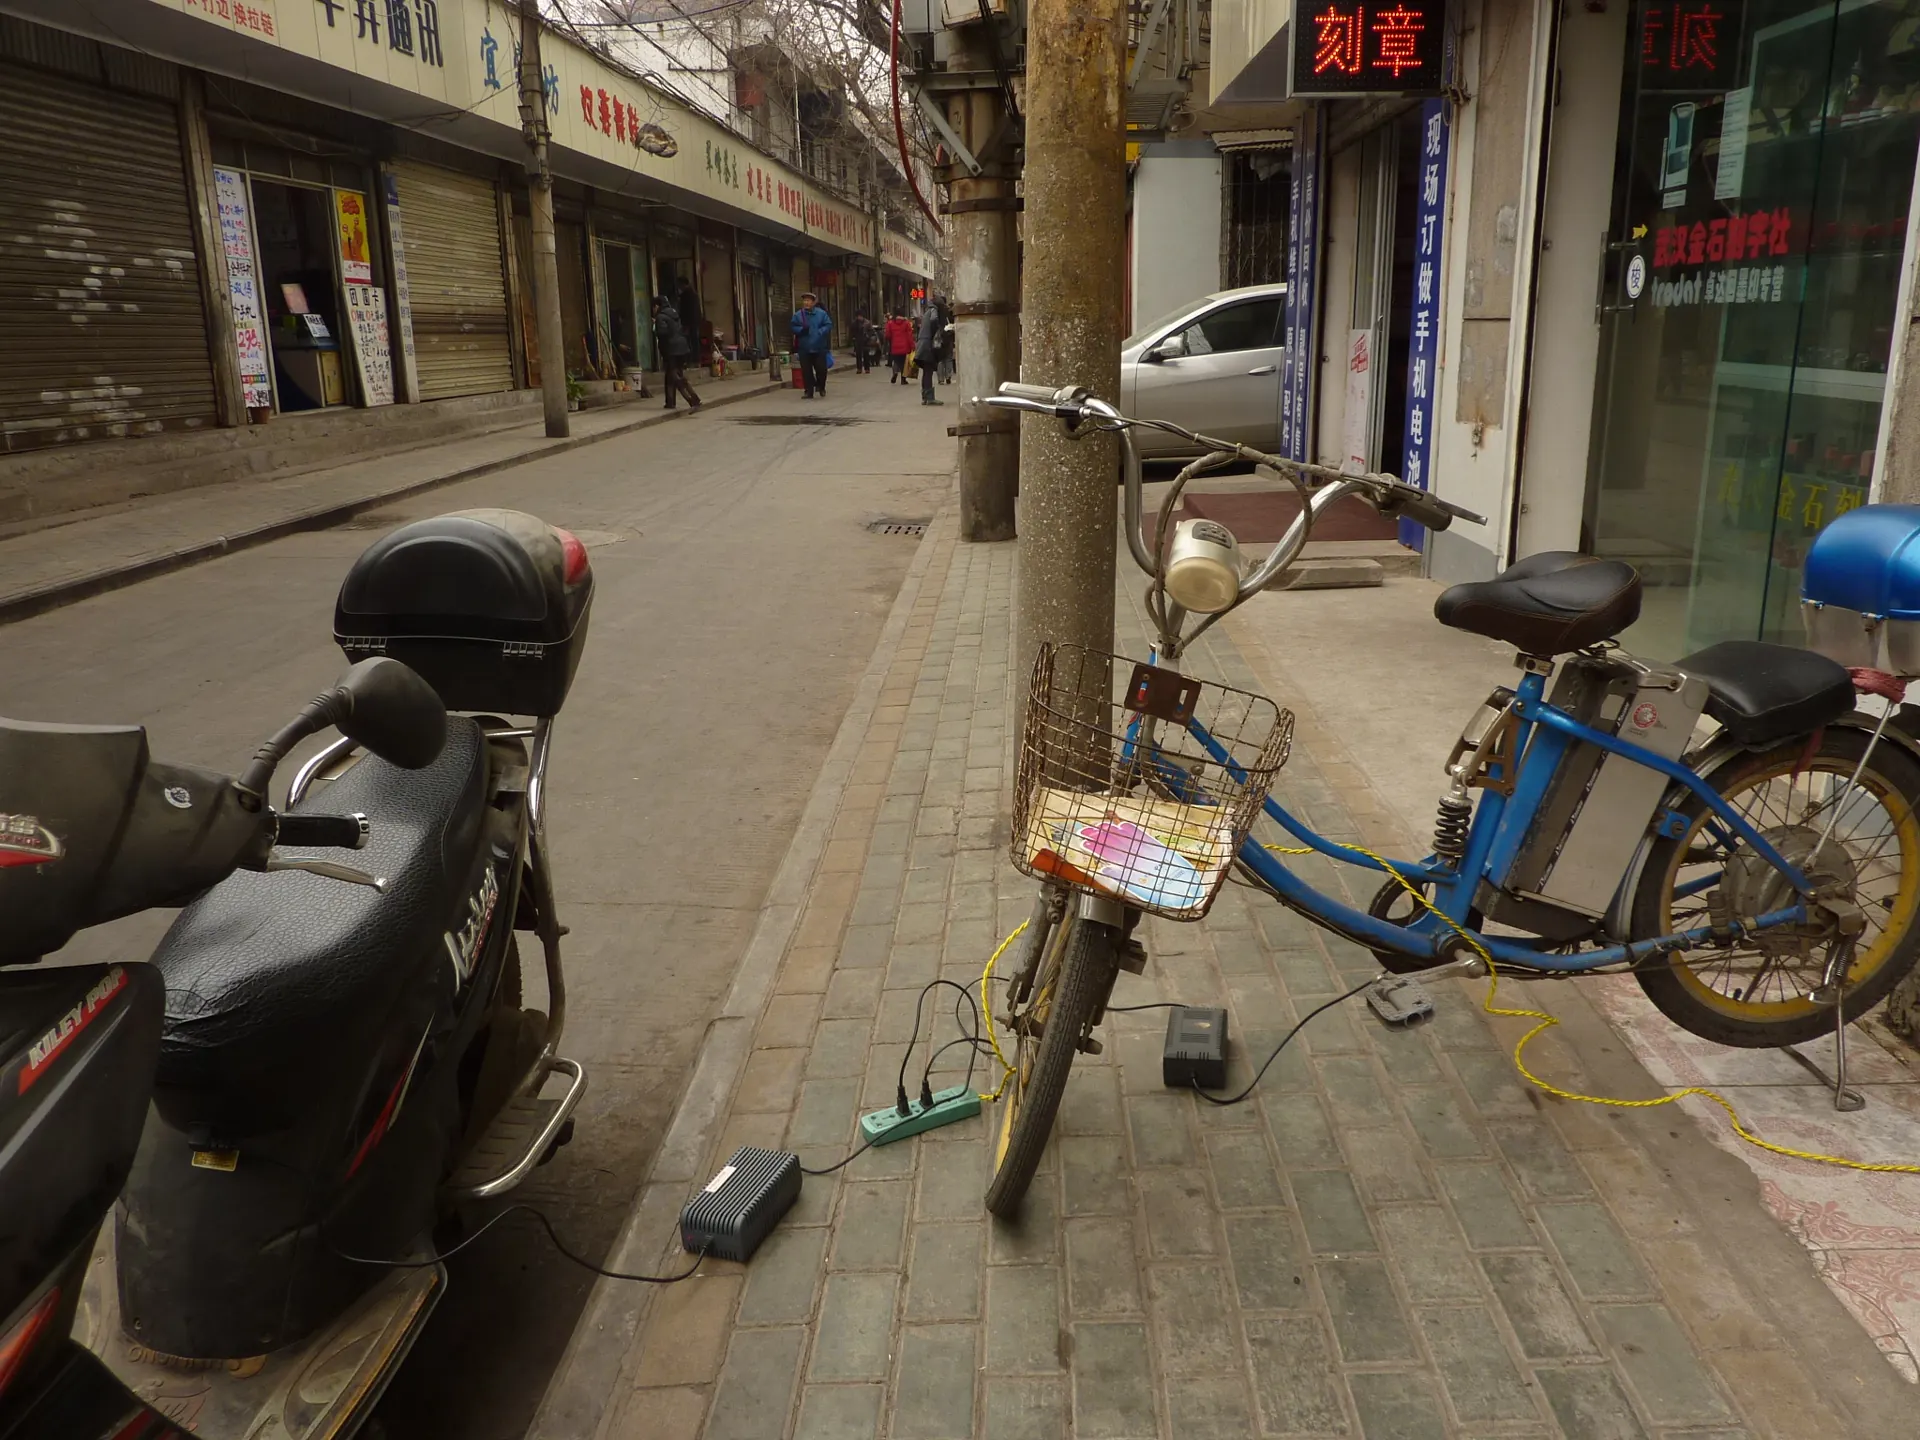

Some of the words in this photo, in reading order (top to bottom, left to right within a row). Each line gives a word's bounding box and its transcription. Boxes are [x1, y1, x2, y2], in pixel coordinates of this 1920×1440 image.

[480, 27, 559, 115] 宜坊
[1314, 3, 1425, 77] 刻章
[1287, 180, 1299, 308] 手机维修
[1704, 264, 1784, 304] 卓达回墨印专营
[1406, 112, 1442, 489] 现场订做手机电池
[1282, 326, 1294, 448] 原厂配件
[29, 1001, 82, 1070] KILEY
[86, 966, 123, 1013] POP
